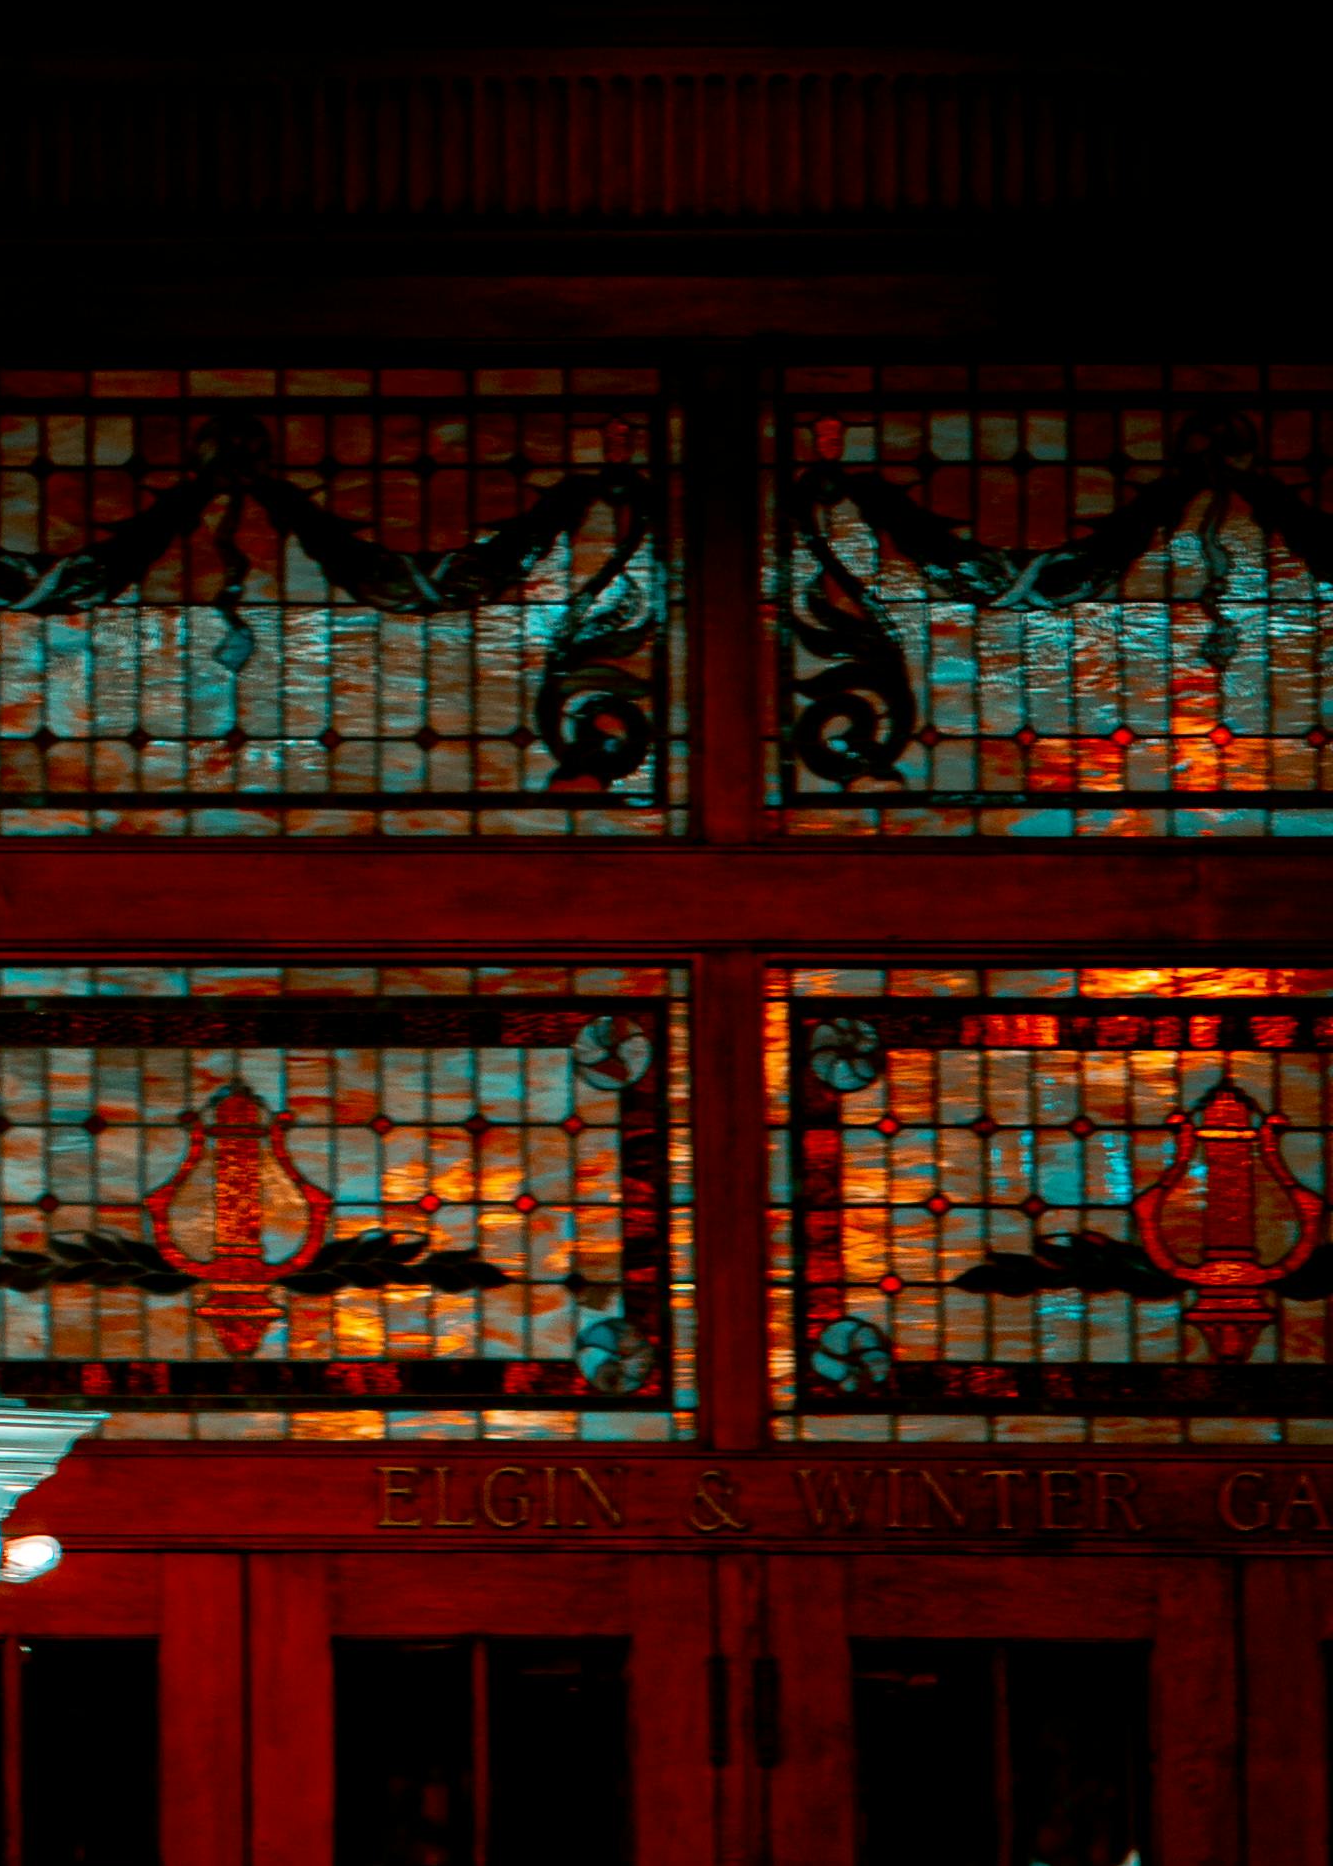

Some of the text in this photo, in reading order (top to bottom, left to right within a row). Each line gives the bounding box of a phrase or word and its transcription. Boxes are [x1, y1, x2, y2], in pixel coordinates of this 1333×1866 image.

[374, 1465, 627, 1529] ELGIN
[688, 1469, 750, 1532] &
[796, 1467, 1145, 1531] WINTER
